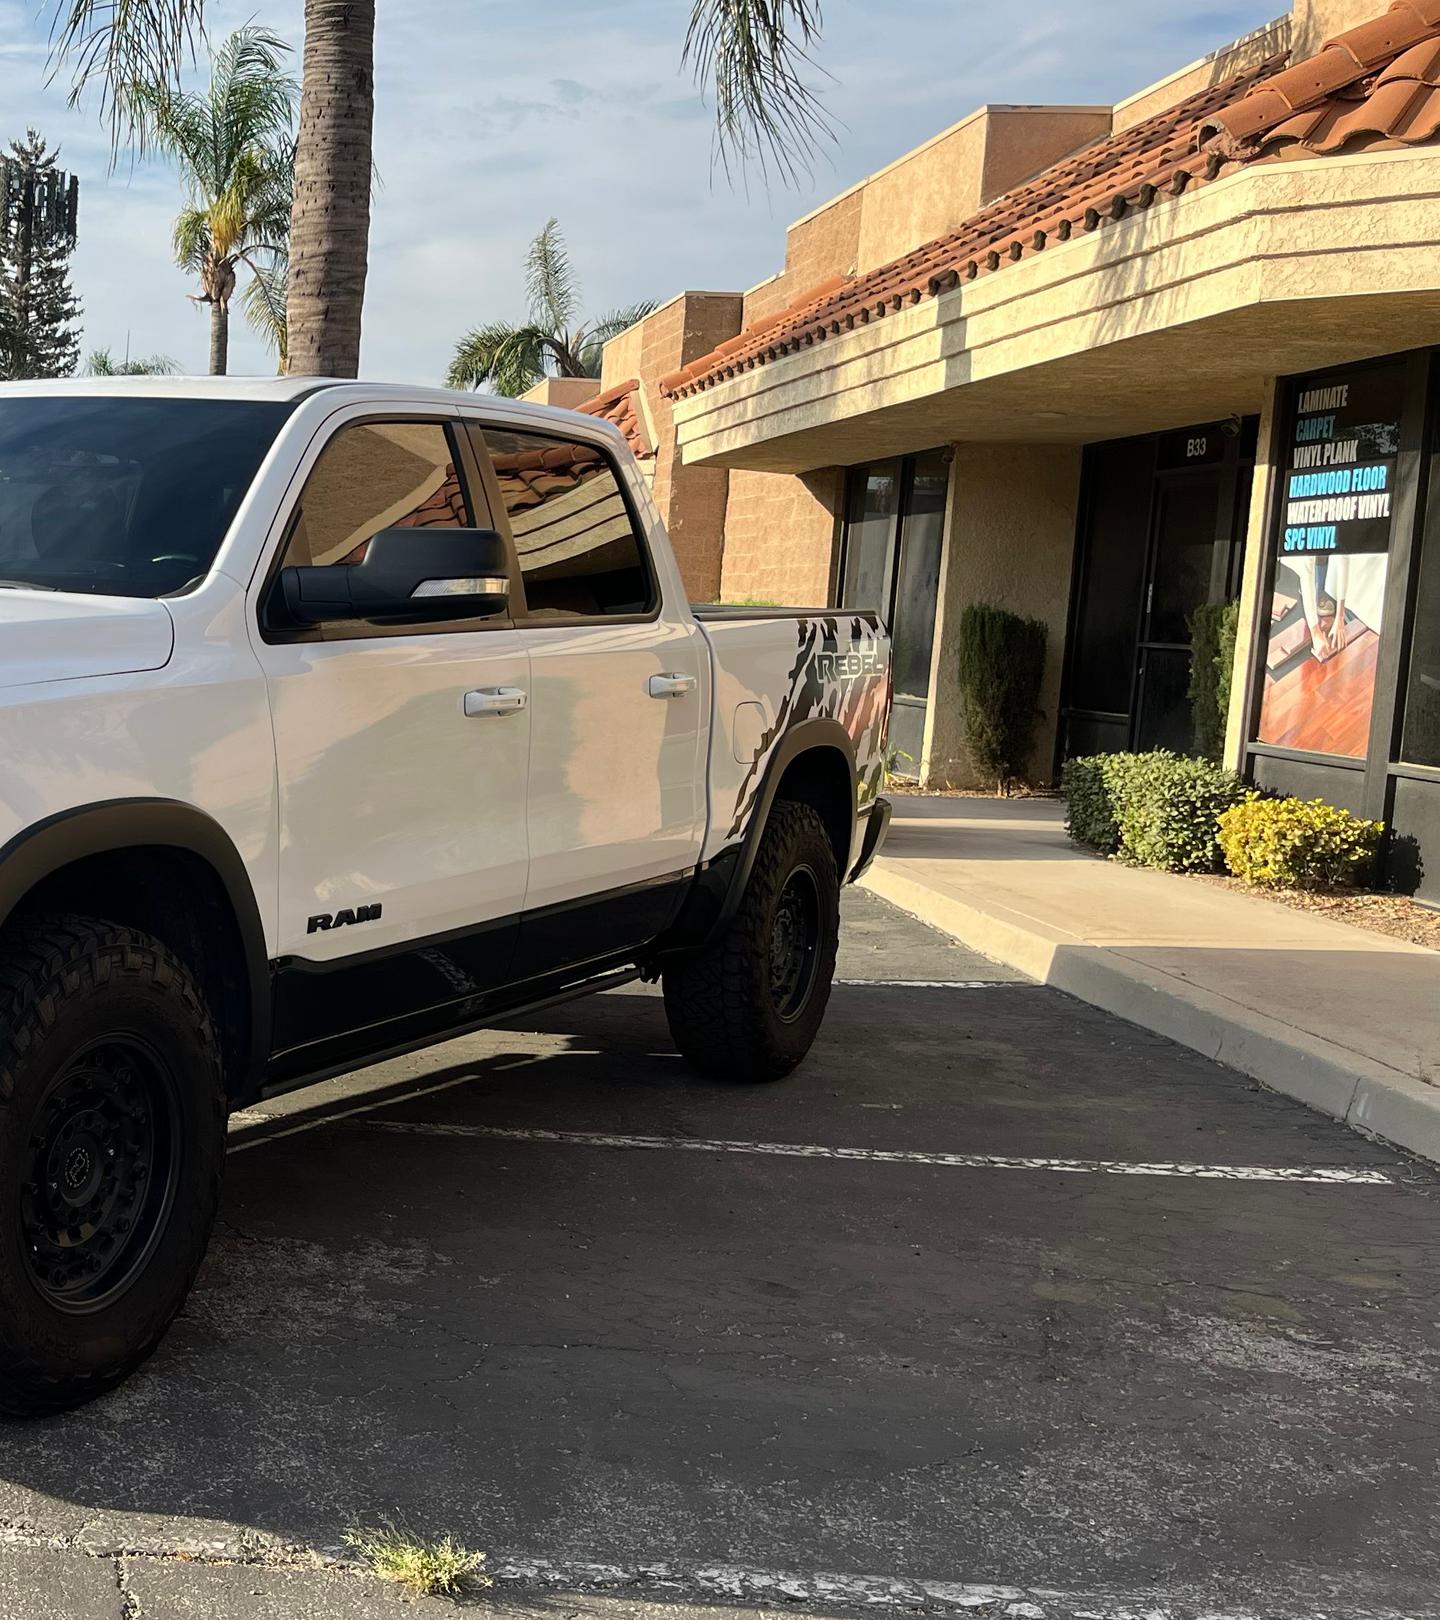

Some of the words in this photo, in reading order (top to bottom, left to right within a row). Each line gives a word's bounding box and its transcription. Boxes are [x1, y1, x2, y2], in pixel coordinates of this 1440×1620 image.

[1298, 385, 1348, 414] LAMINATE
[1296, 415, 1336, 442] CARPET
[1187, 437, 1207, 457] B33
[1293, 445, 1321, 469] VINYL
[1322, 440, 1359, 465] PLANK
[1289, 470, 1351, 498] HARDWOOD
[1351, 466, 1387, 492] FLOOR
[1287, 496, 1357, 525] WATERPROOF
[1357, 493, 1390, 520] VINYL
[1284, 527, 1306, 551] SPC
[1306, 526, 1336, 550] VINYL
[816, 651, 885, 684] REBEL
[306, 903, 382, 934] RAM
